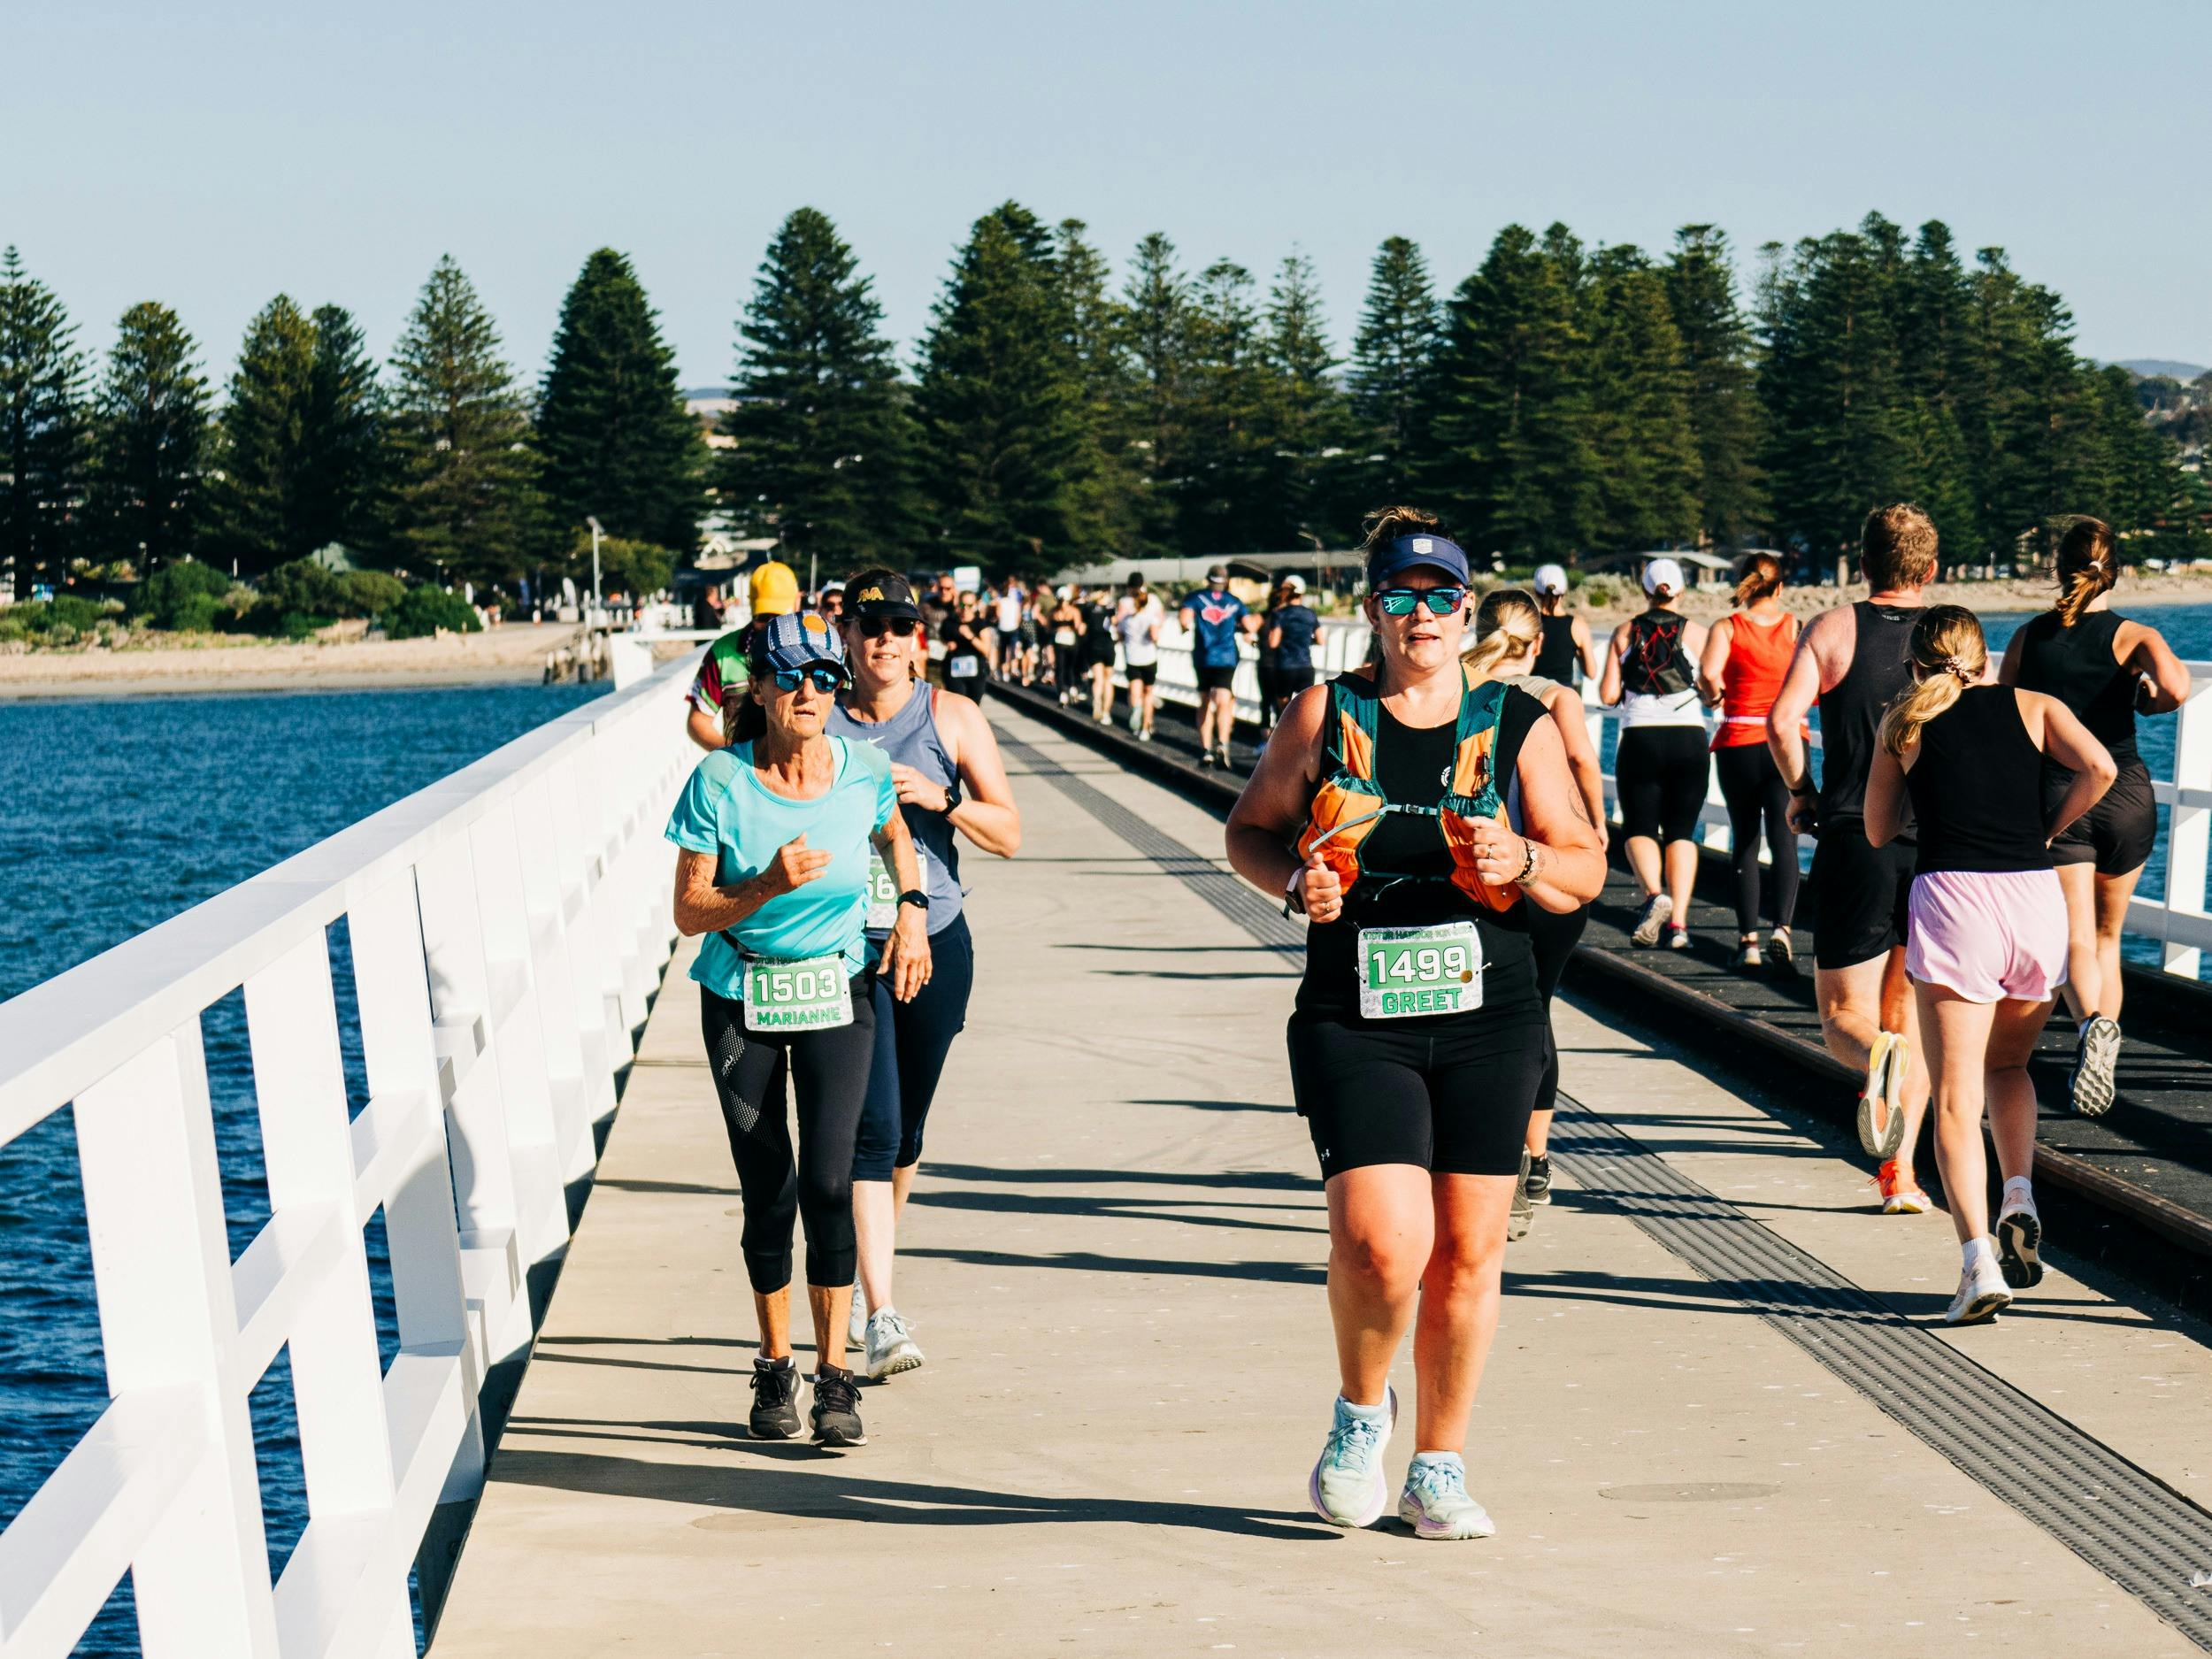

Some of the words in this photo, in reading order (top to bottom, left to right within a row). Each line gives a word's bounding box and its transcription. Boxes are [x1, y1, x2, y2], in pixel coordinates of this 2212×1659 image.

[1372, 946, 1467, 984] 1499
[757, 968, 837, 1002] 1503
[1382, 987, 1463, 1014] GREET
[757, 1007, 841, 1025] MARIANNE
